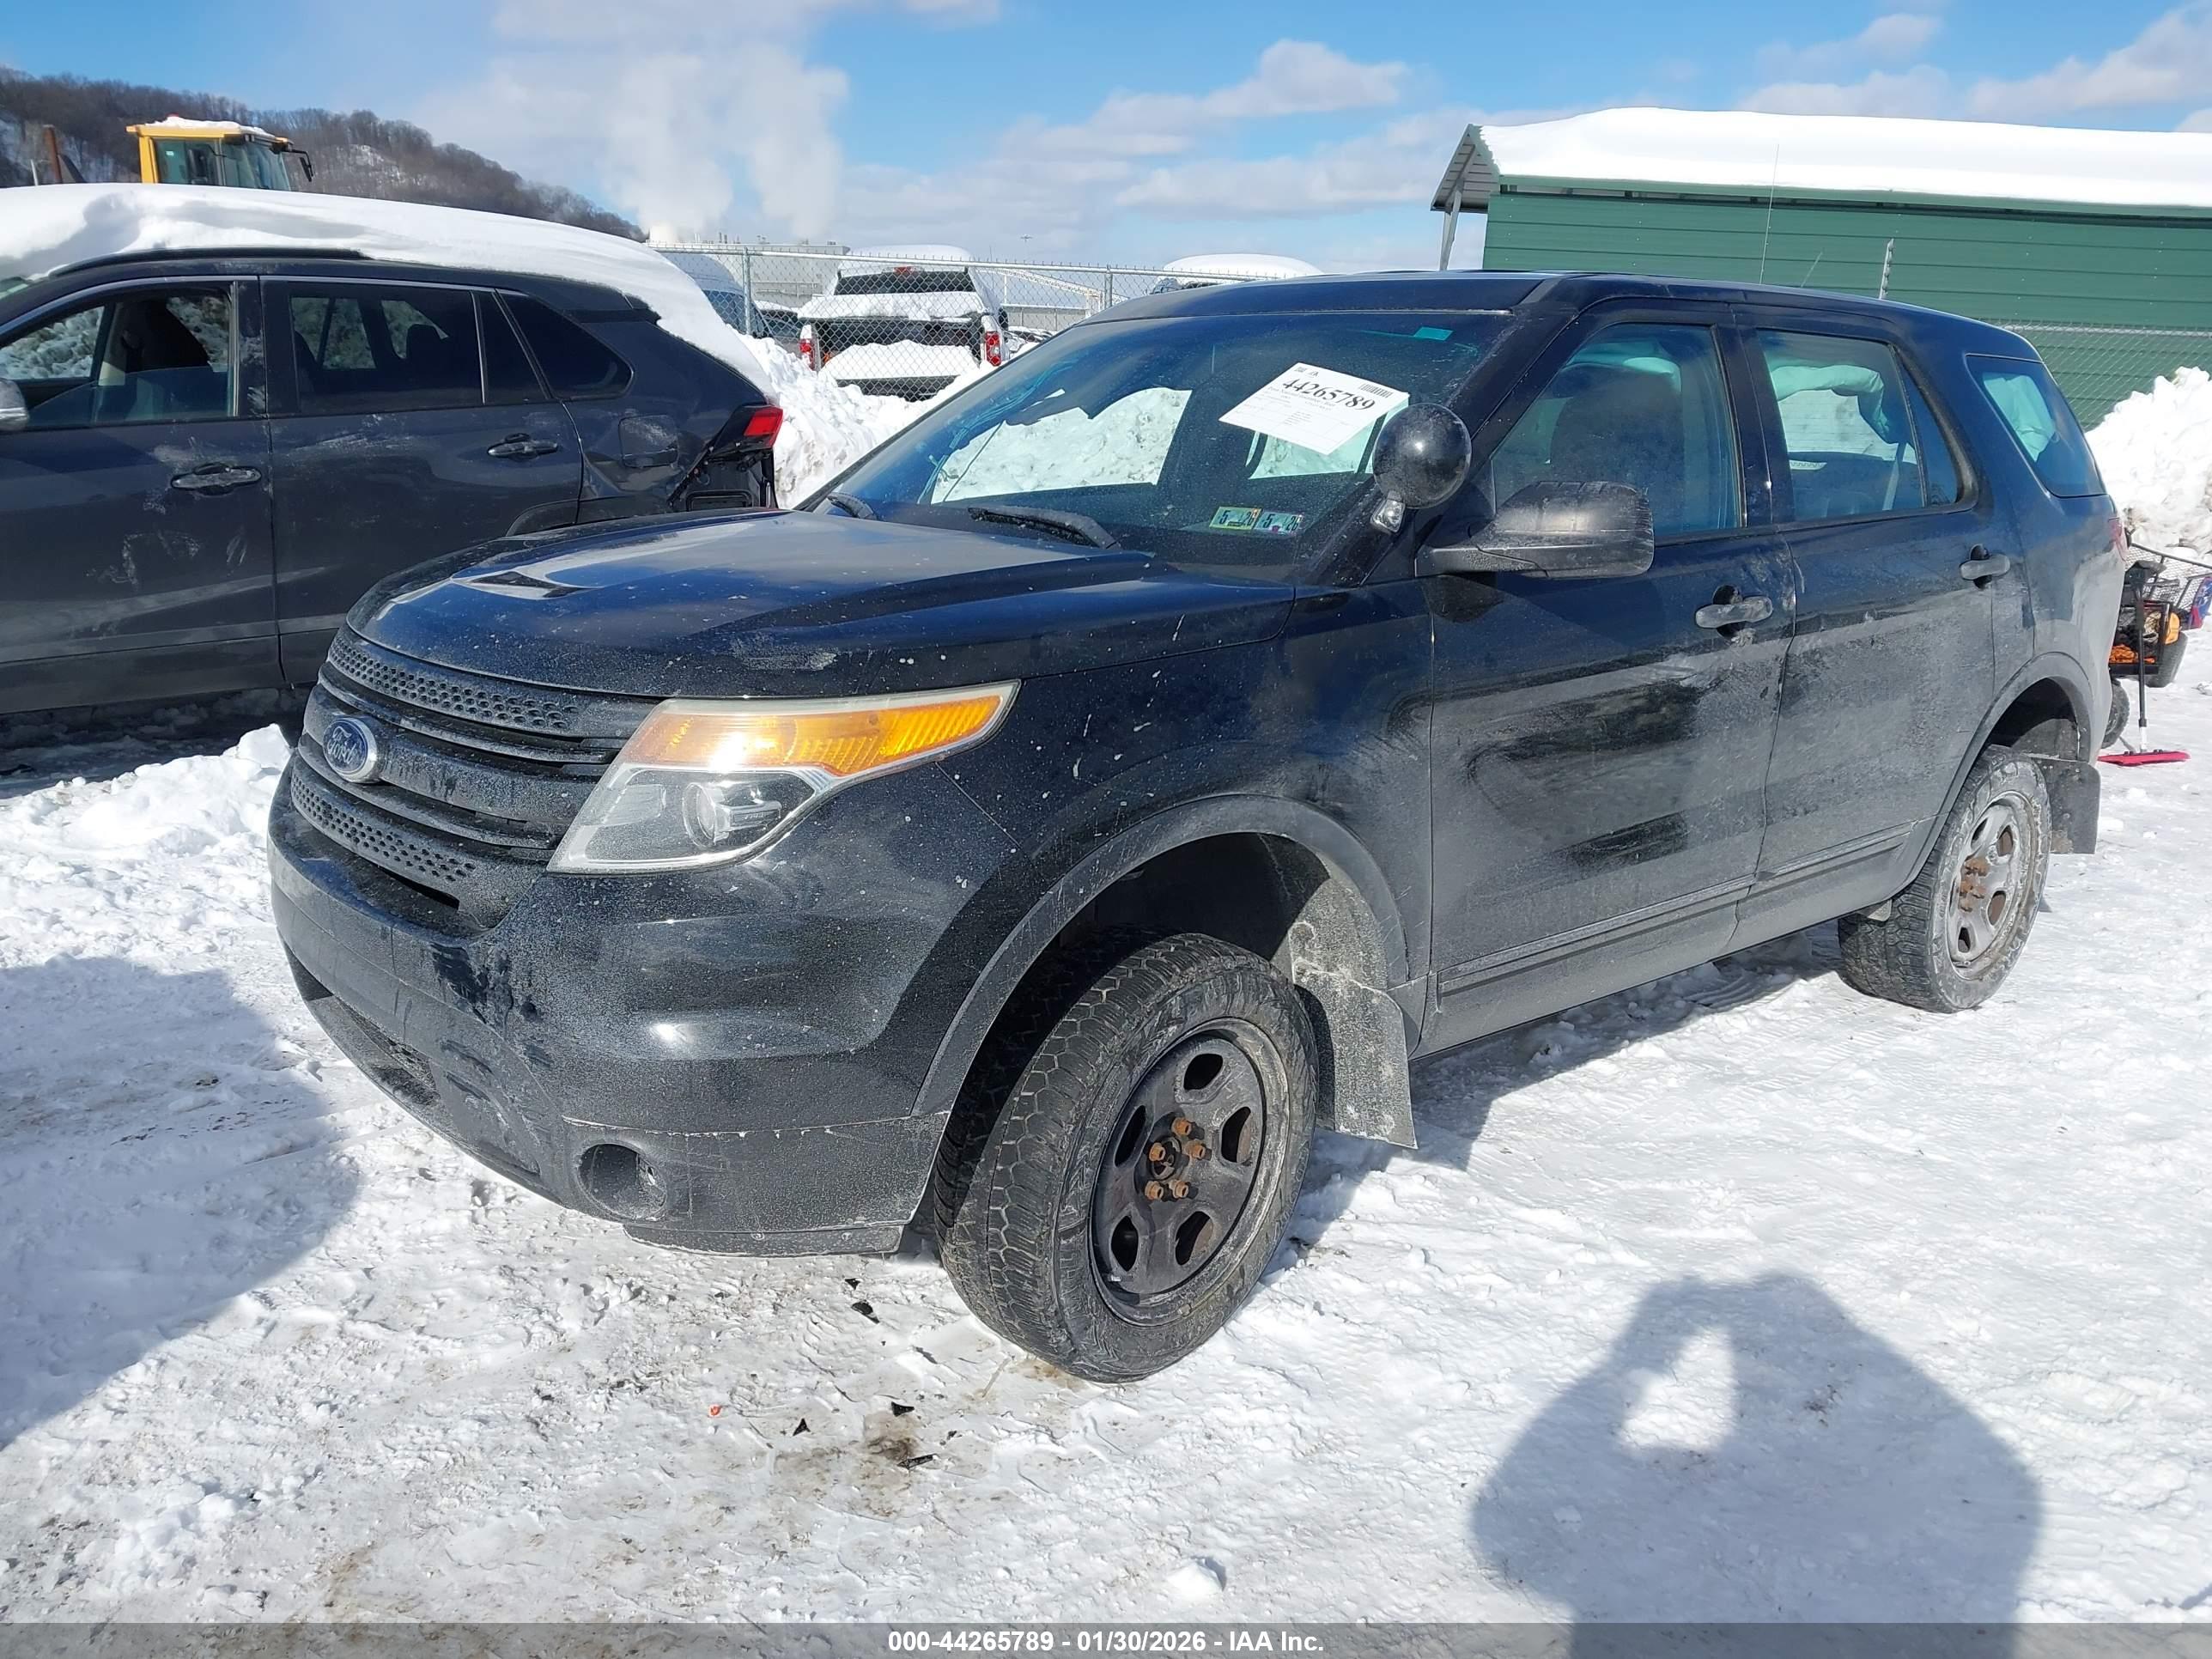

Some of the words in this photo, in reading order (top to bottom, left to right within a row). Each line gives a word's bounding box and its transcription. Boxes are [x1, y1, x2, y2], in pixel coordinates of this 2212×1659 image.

[1282, 378, 1376, 410] 44265789
[1218, 510, 1231, 525] 5
[1263, 514, 1275, 528] 5
[327, 726, 356, 764] Ford
